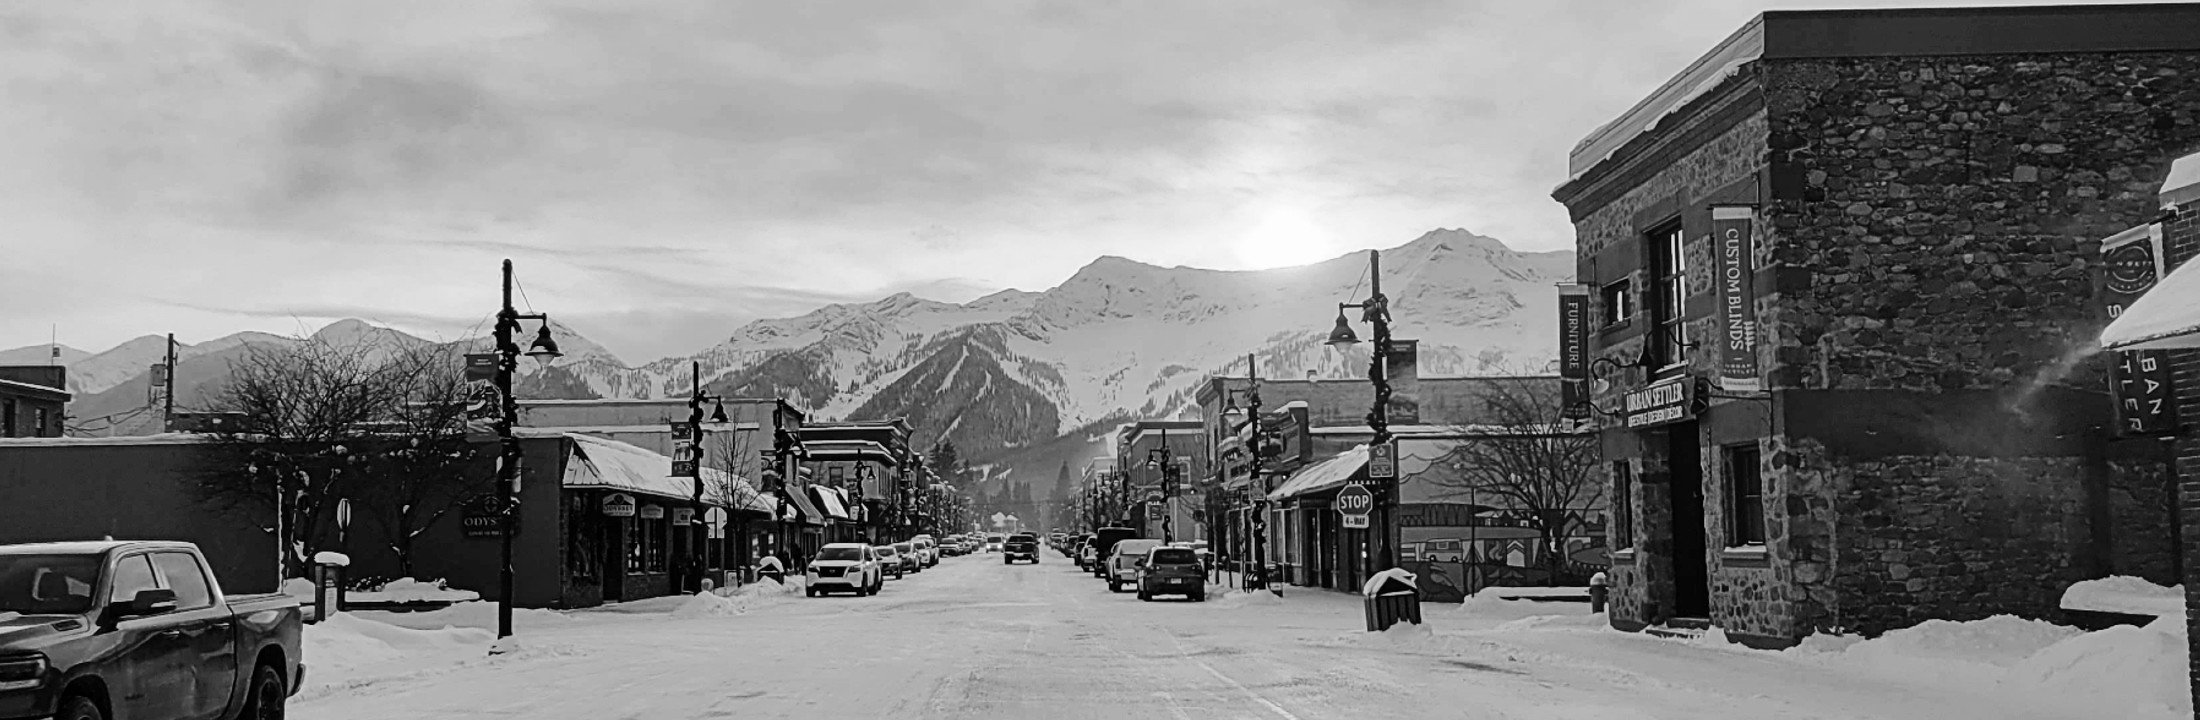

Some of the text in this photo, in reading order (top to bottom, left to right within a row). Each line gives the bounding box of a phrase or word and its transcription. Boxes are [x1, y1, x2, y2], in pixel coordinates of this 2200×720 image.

[1725, 228, 1744, 350] CUSTOM BLINDS
[1567, 301, 1579, 370] FURNITURE
[1626, 382, 1685, 413] URBAN SETTLER
[2141, 357, 2162, 415] BAN
[464, 517, 498, 526] ODYS
[1340, 494, 1370, 509] STOP
